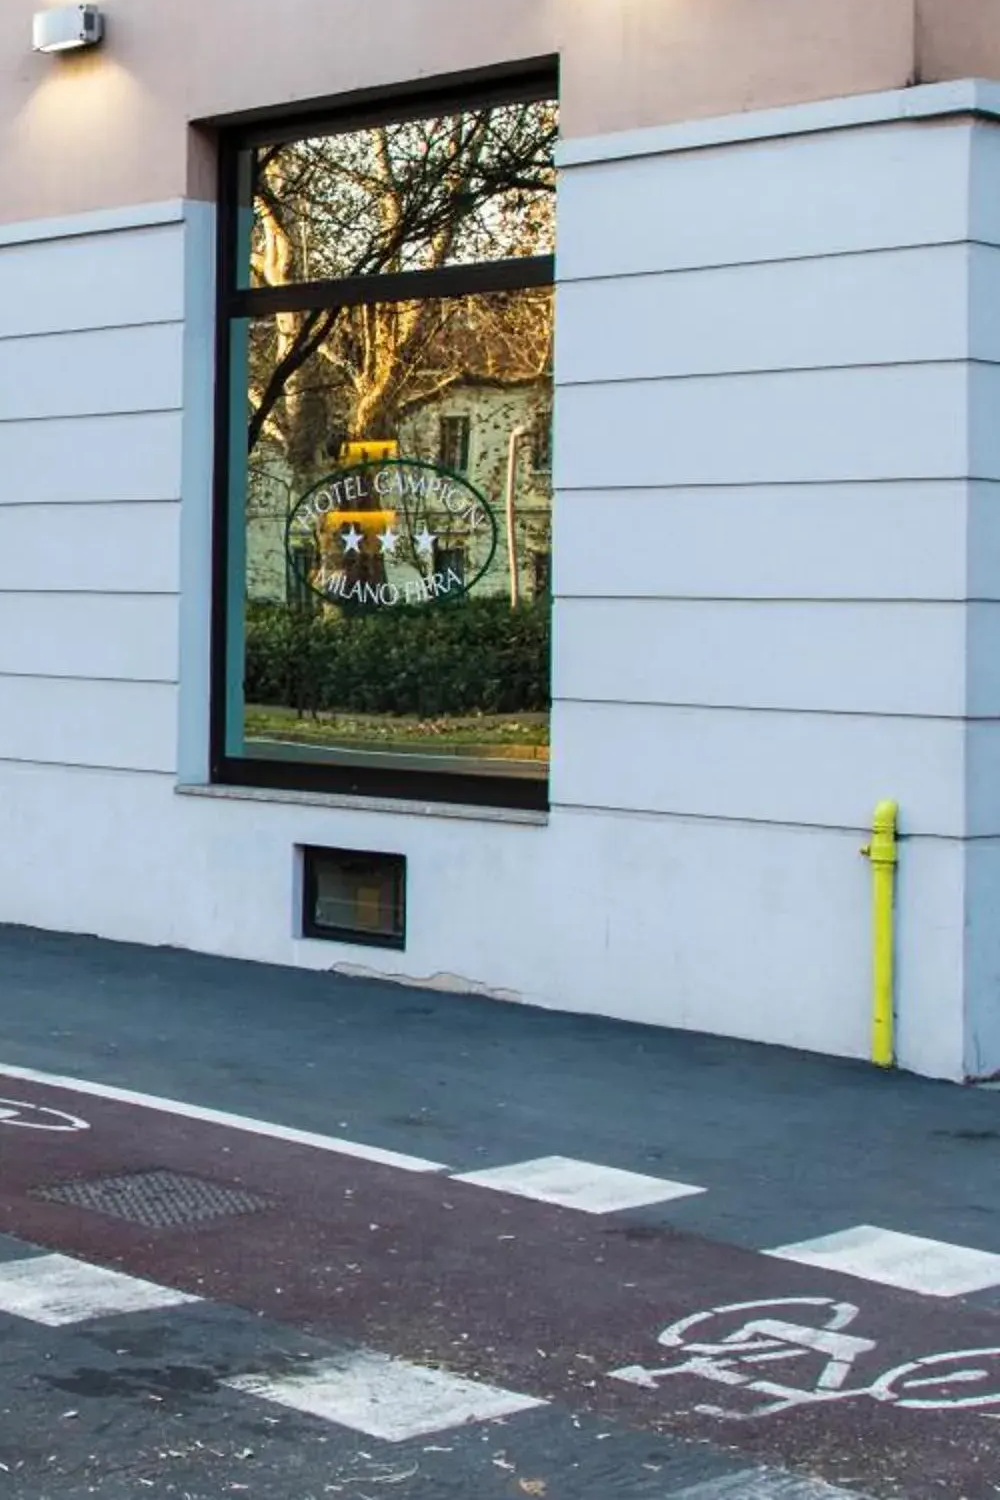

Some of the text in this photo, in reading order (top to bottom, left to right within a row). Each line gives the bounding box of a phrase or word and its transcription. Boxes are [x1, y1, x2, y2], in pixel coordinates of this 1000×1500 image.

[296, 470, 486, 531] HOTEL CAMPION
[314, 567, 463, 606] MILANO FIERA
